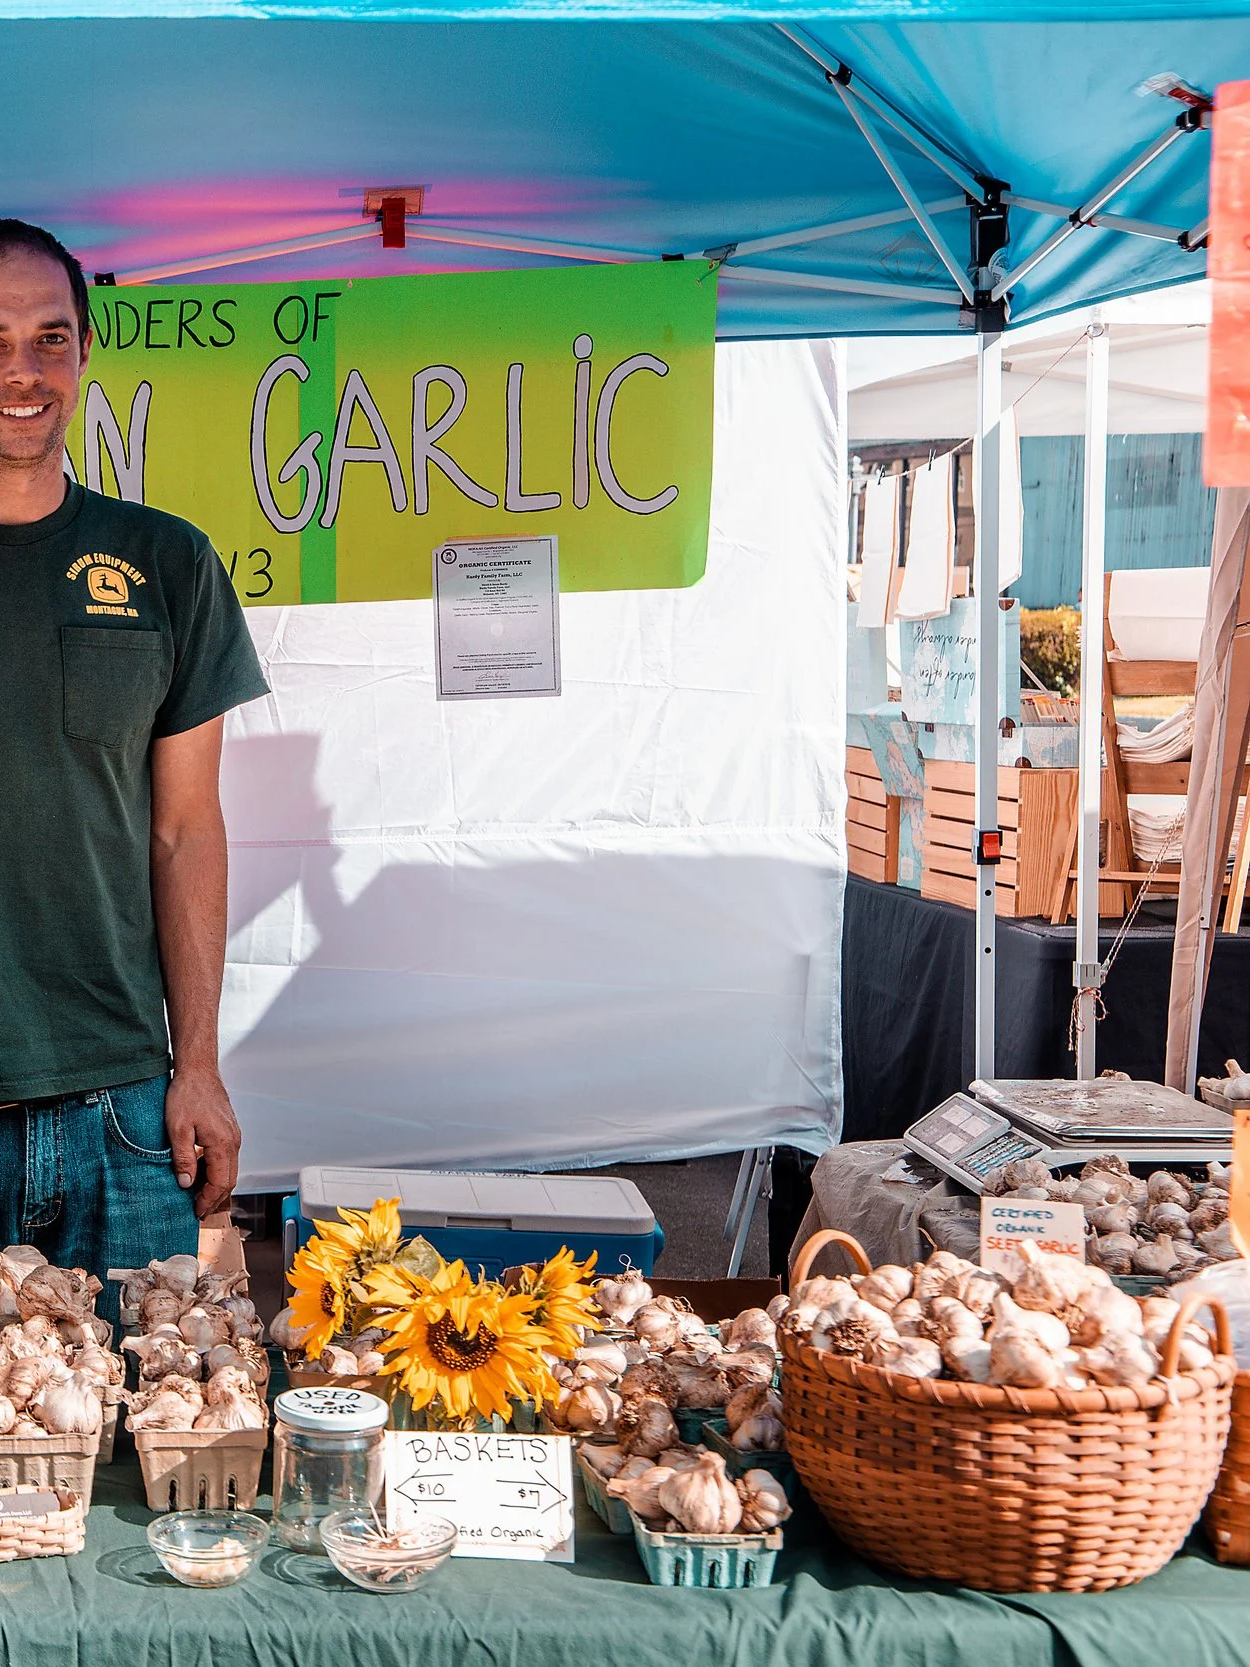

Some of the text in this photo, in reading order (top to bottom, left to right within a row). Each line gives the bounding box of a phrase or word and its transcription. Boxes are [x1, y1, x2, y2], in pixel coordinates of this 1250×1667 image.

[88, 292, 342, 350] NDERS OF
[66, 552, 147, 586] SIRUM EQUIPMENT
[458, 559, 532, 569] ORGANIC CERTIFICATE
[919, 656, 942, 697] often
[294, 1390, 361, 1401] USED
[406, 1436, 547, 1463] BASKETS
[418, 1483, 540, 1506] $10 $7
[491, 1526, 544, 1542] Organic
